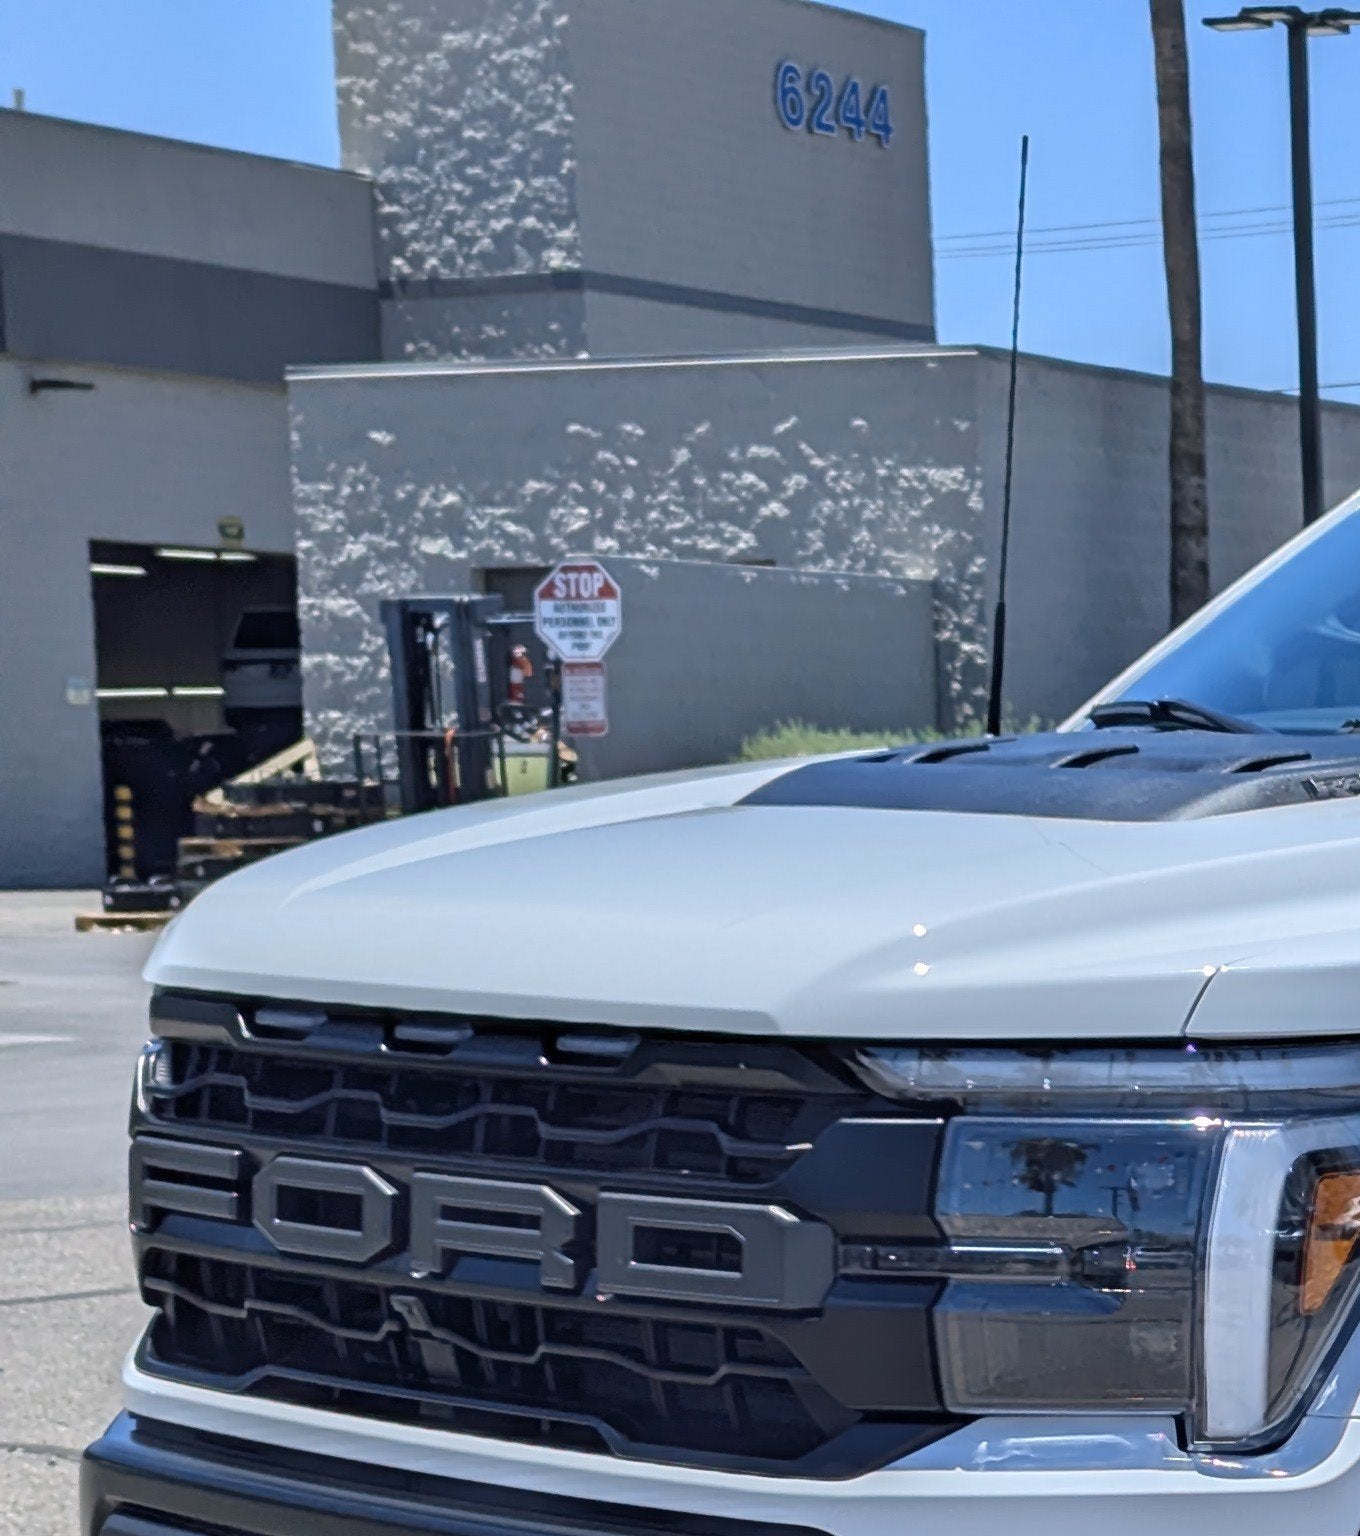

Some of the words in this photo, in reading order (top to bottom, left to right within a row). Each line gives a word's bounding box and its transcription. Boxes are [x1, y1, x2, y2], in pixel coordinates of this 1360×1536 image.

[777, 61, 894, 149] 6244
[553, 572, 605, 598] STOP
[129, 1137, 838, 1313] FORD
